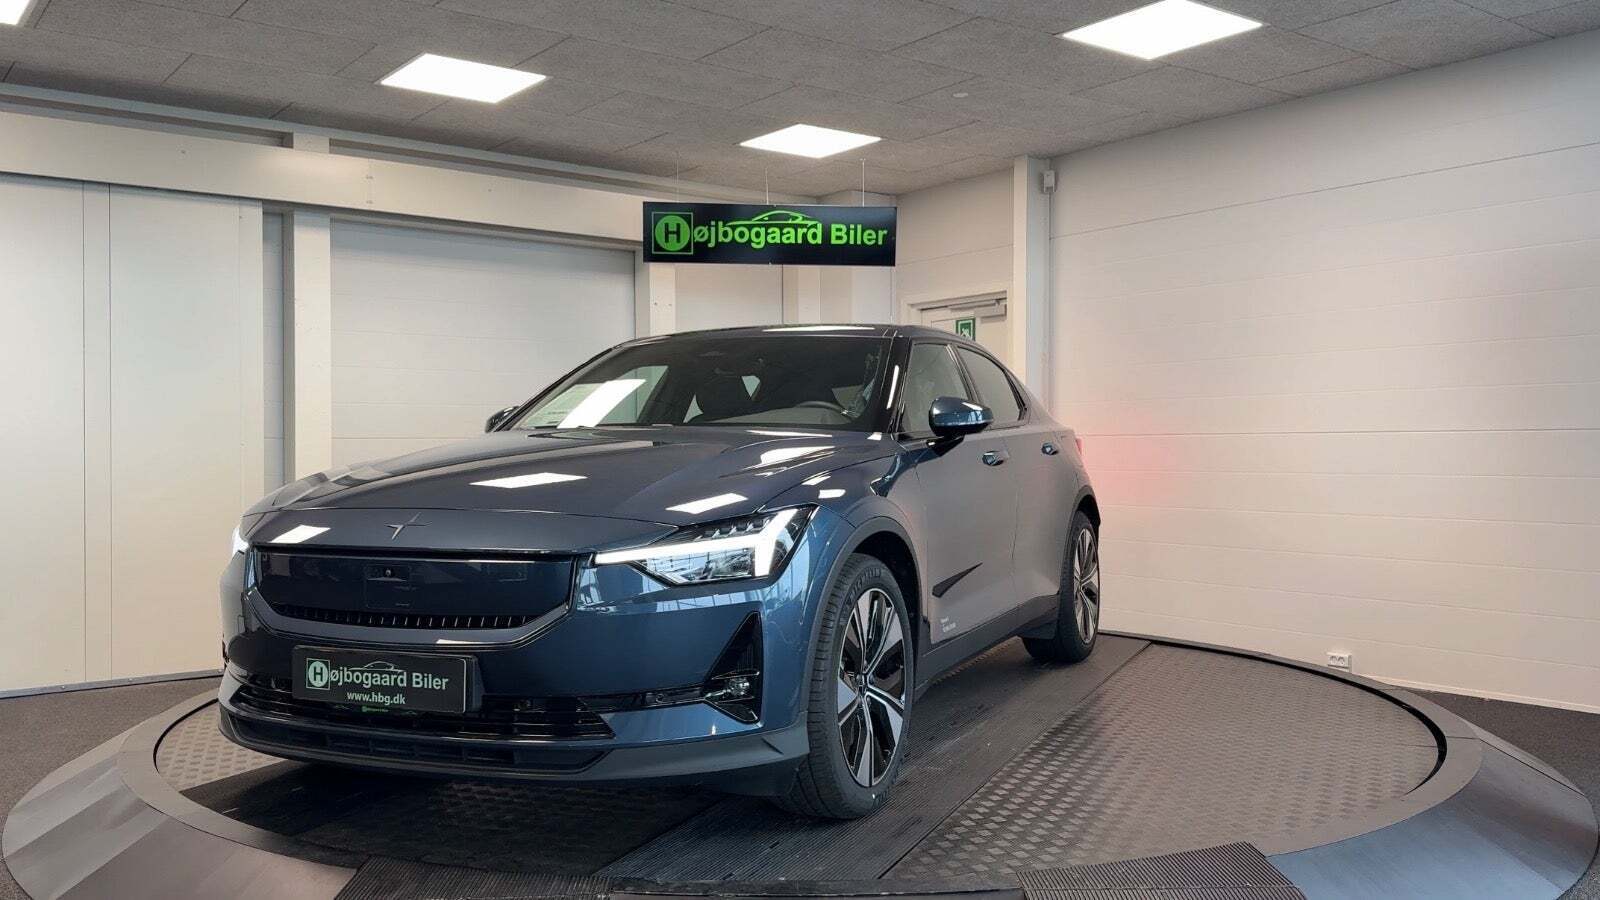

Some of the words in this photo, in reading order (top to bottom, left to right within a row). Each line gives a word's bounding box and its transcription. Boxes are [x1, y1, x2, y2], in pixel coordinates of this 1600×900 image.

[655, 215, 822, 250] Højbogaard
[830, 224, 887, 245] Biler
[308, 660, 407, 689] Højbogaard
[412, 672, 449, 690] Biler
[347, 691, 406, 705] www.hbg.dk
